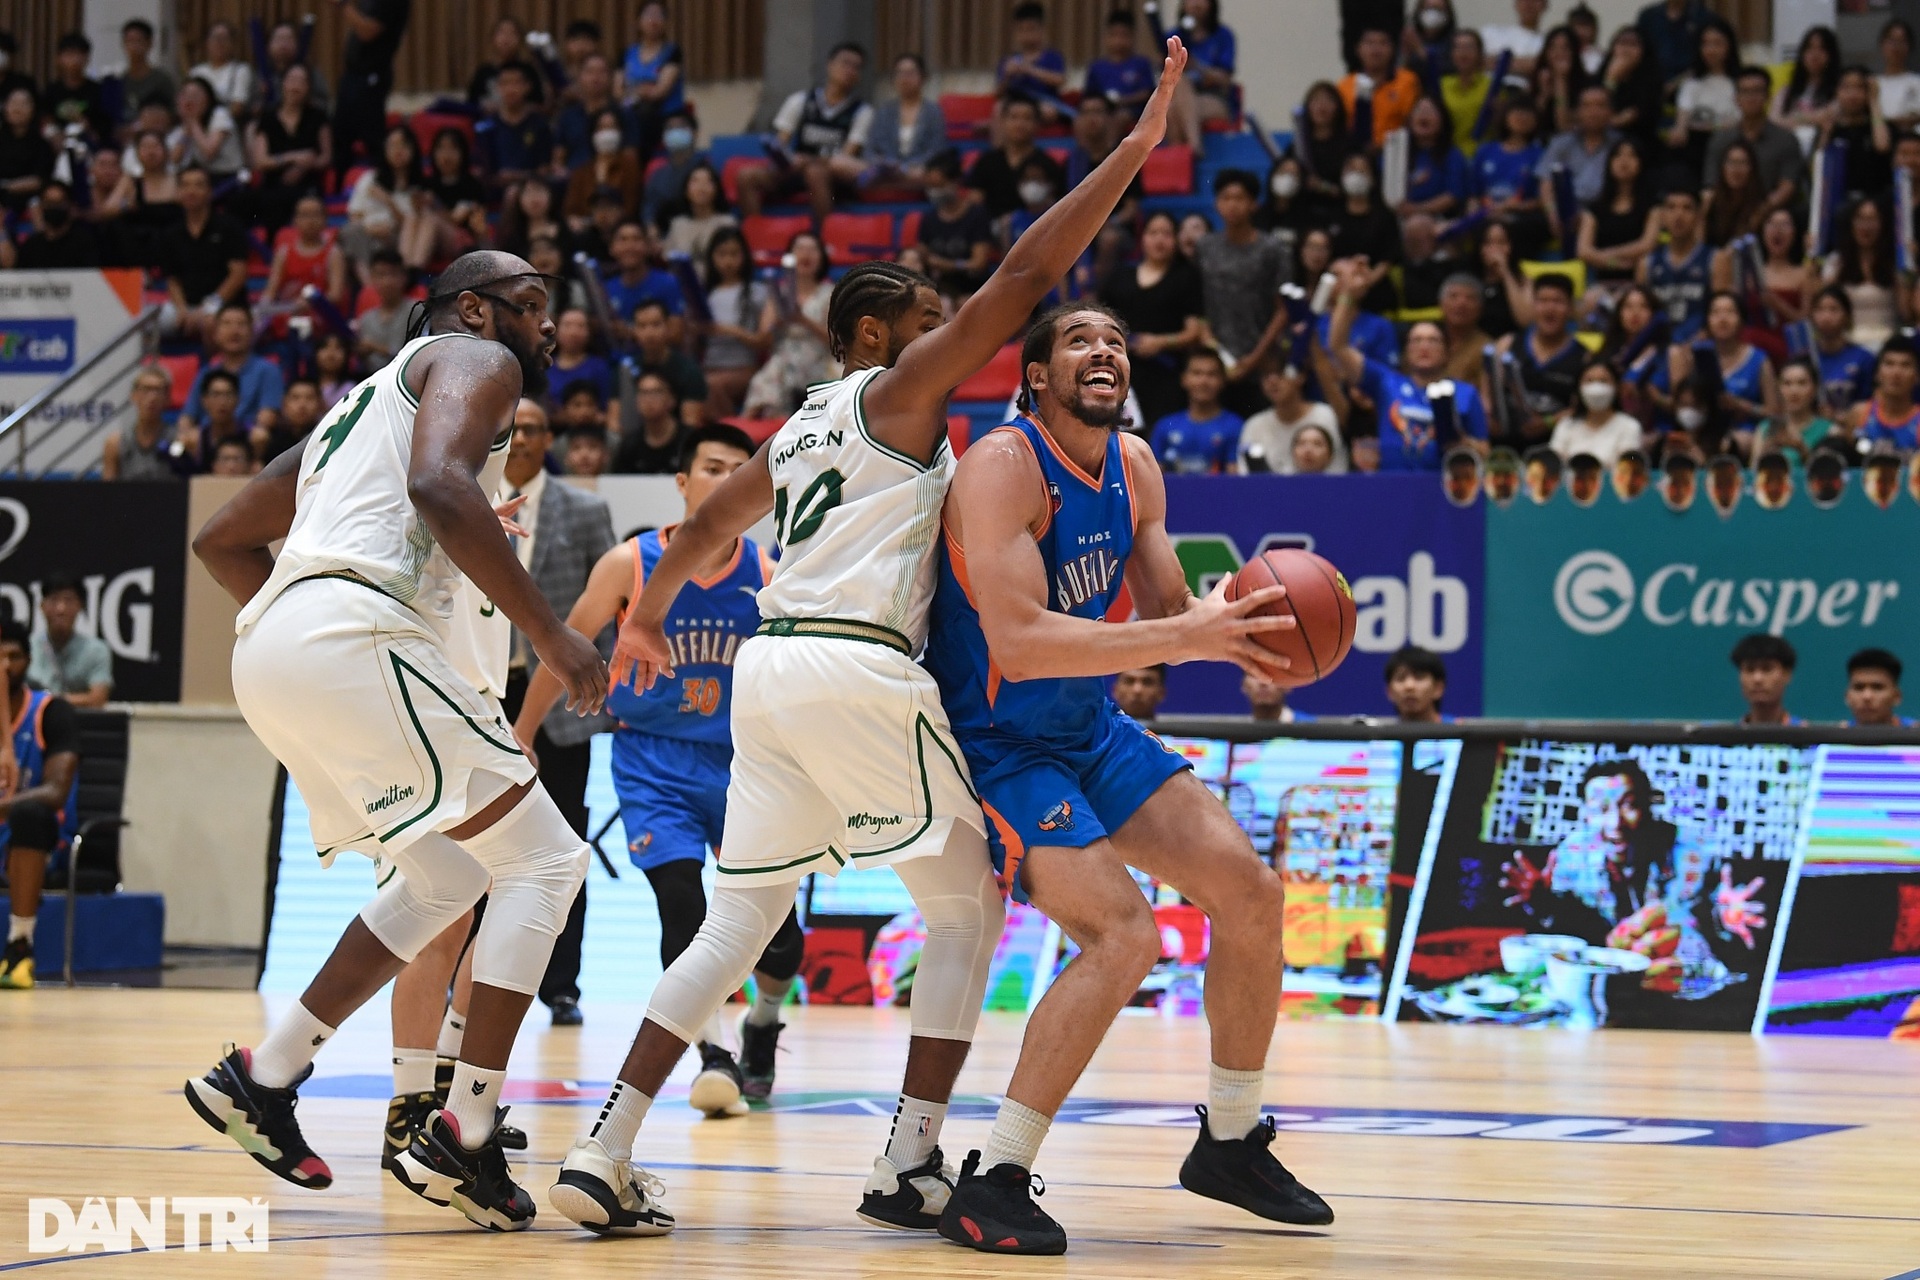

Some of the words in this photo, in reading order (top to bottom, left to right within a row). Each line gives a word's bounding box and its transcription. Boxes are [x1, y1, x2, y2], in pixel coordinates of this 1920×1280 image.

[1642, 563, 1900, 638] Casper
[676, 618, 734, 628] HANOI
[667, 631, 749, 667] UFFALO
[678, 678, 721, 716] 30
